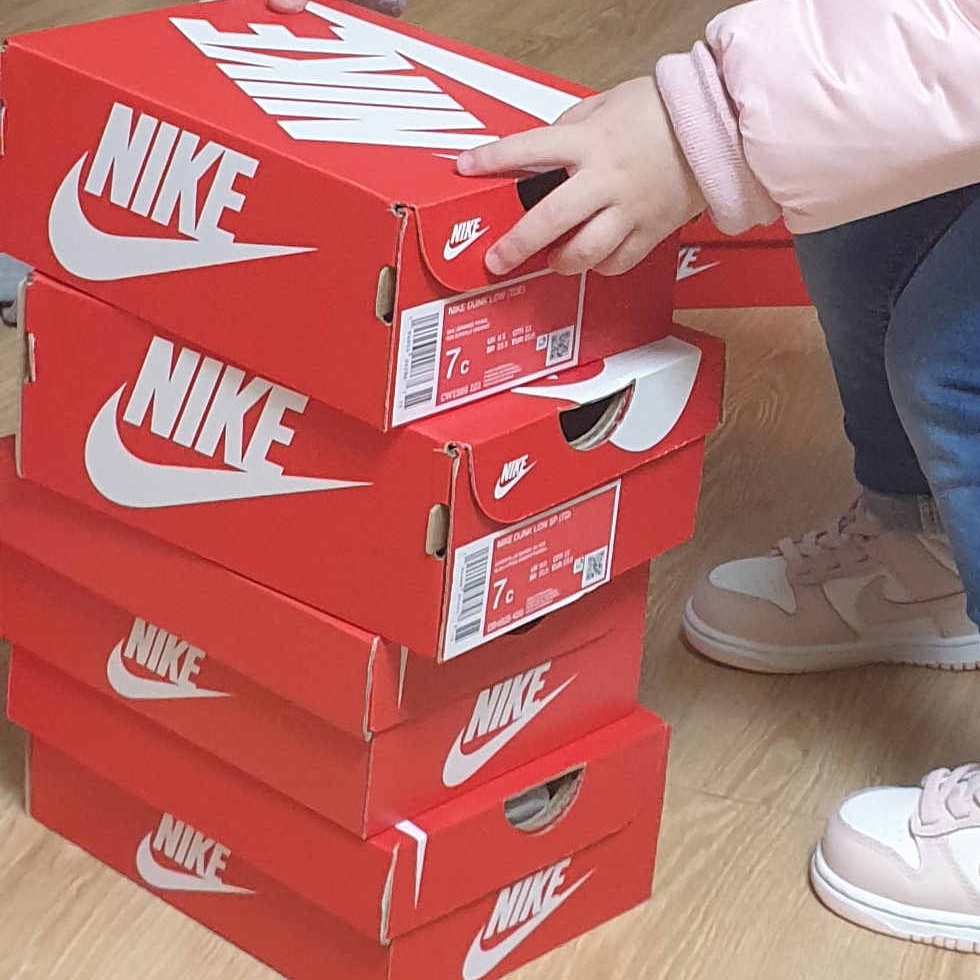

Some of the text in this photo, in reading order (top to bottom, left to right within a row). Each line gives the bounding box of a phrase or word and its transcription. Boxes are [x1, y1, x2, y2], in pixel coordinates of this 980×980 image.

[169, 17, 501, 150] NIKE
[83, 101, 260, 244] NIKE
[449, 217, 482, 245] NIKE
[123, 335, 309, 477] NIKE
[500, 453, 530, 485] NIKE
[123, 617, 207, 690] NIKE
[463, 661, 552, 745] NIKE
[152, 811, 232, 884] NIKE
[483, 856, 572, 941] NIKE
